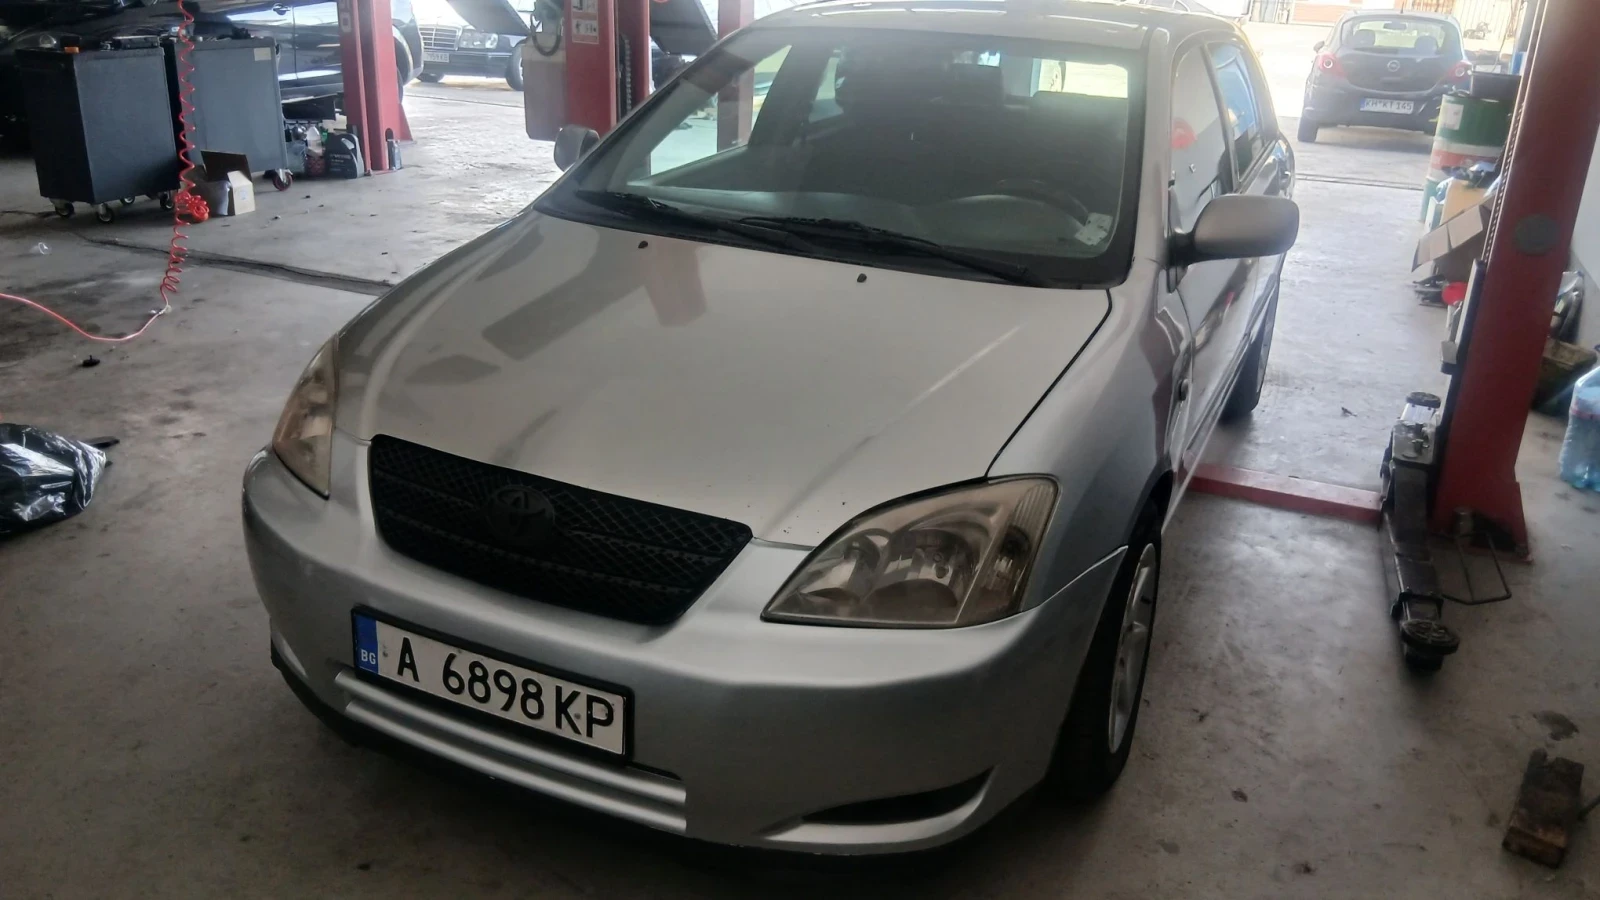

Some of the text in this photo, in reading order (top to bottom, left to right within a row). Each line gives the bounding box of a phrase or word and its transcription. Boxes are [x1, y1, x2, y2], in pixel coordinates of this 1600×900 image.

[361, 649, 376, 665] BG
[397, 636, 614, 738] A 6898 KP
